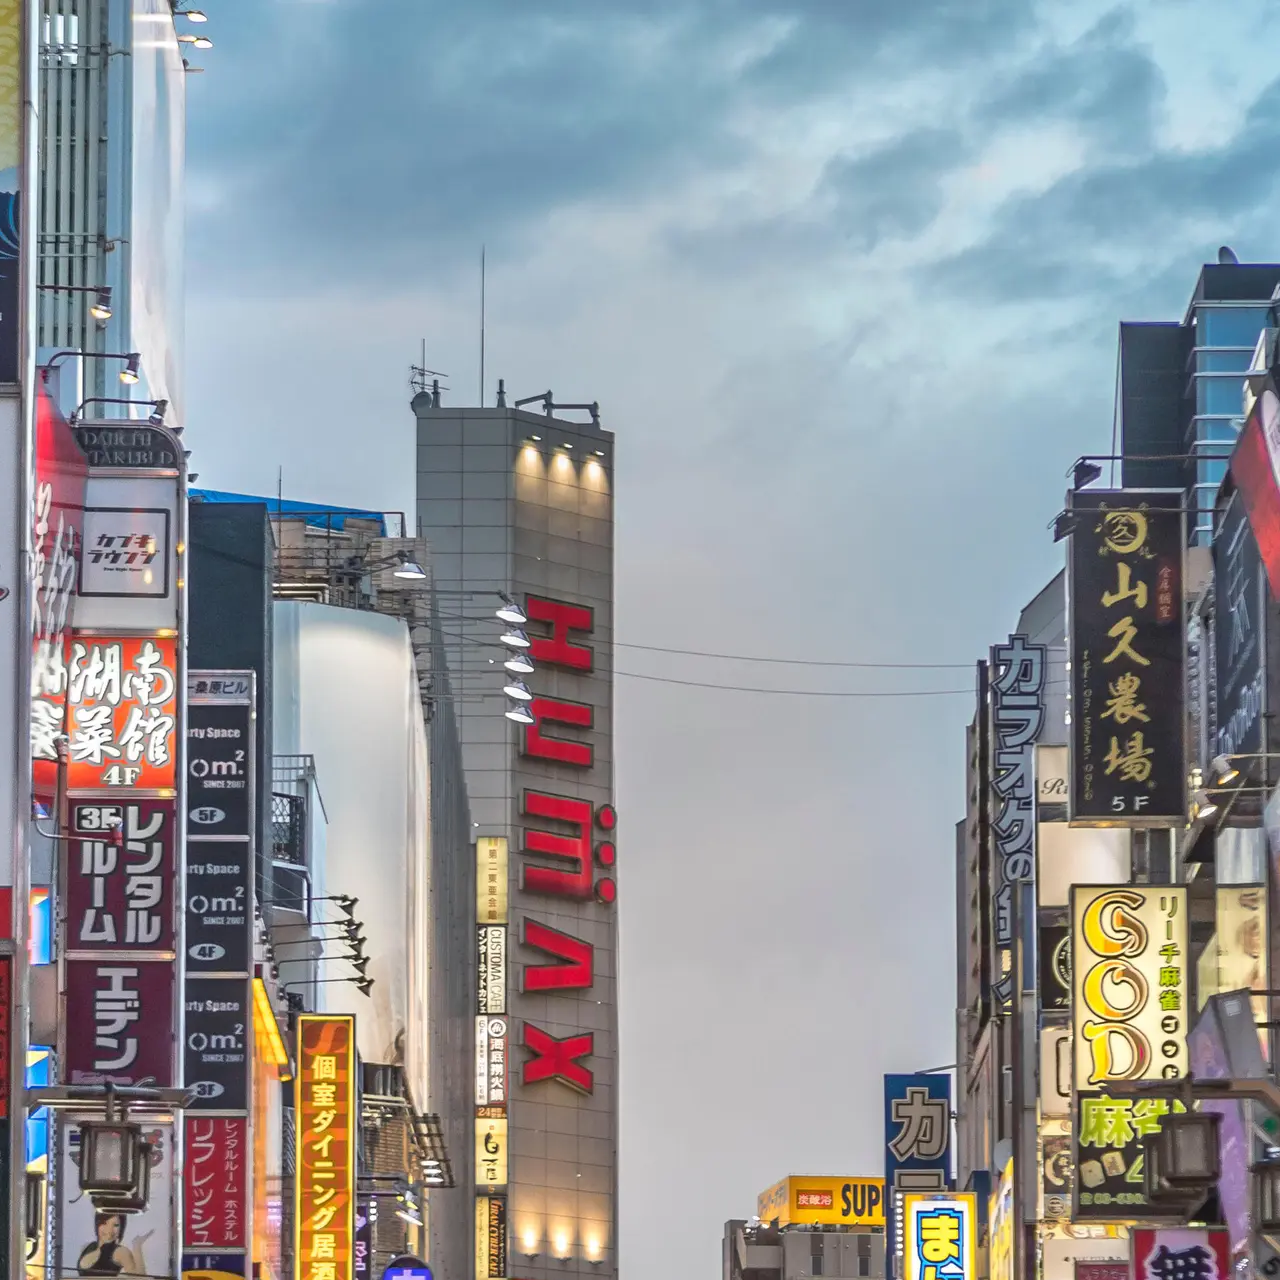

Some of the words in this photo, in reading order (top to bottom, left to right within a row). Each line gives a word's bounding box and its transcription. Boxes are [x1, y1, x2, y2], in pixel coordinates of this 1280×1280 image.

[87, 550, 161, 564] ラウンジ
[97, 533, 156, 549] カブキ
[70, 642, 175, 706] 湖南
[1101, 561, 1156, 783] 山久農場
[208, 727, 241, 741] Space
[102, 765, 141, 786] 4F
[198, 809, 218, 823] 5F
[125, 807, 164, 944] レンタル
[207, 863, 240, 878] Space
[79, 842, 118, 942] ルーム
[197, 944, 217, 958] 4F
[489, 928, 503, 983] CUSTOMA
[1159, 896, 1181, 1011] リーチ麻雀
[206, 1000, 240, 1014] Space
[489, 985, 503, 1012] CAFE
[1081, 890, 1152, 1085] GOD
[94, 967, 141, 1072] エデン
[196, 1082, 217, 1096] 3F
[223, 1119, 239, 1193] レンタルルーム
[190, 1119, 215, 1246] リフレッシュ
[223, 1200, 239, 1242] ホステル
